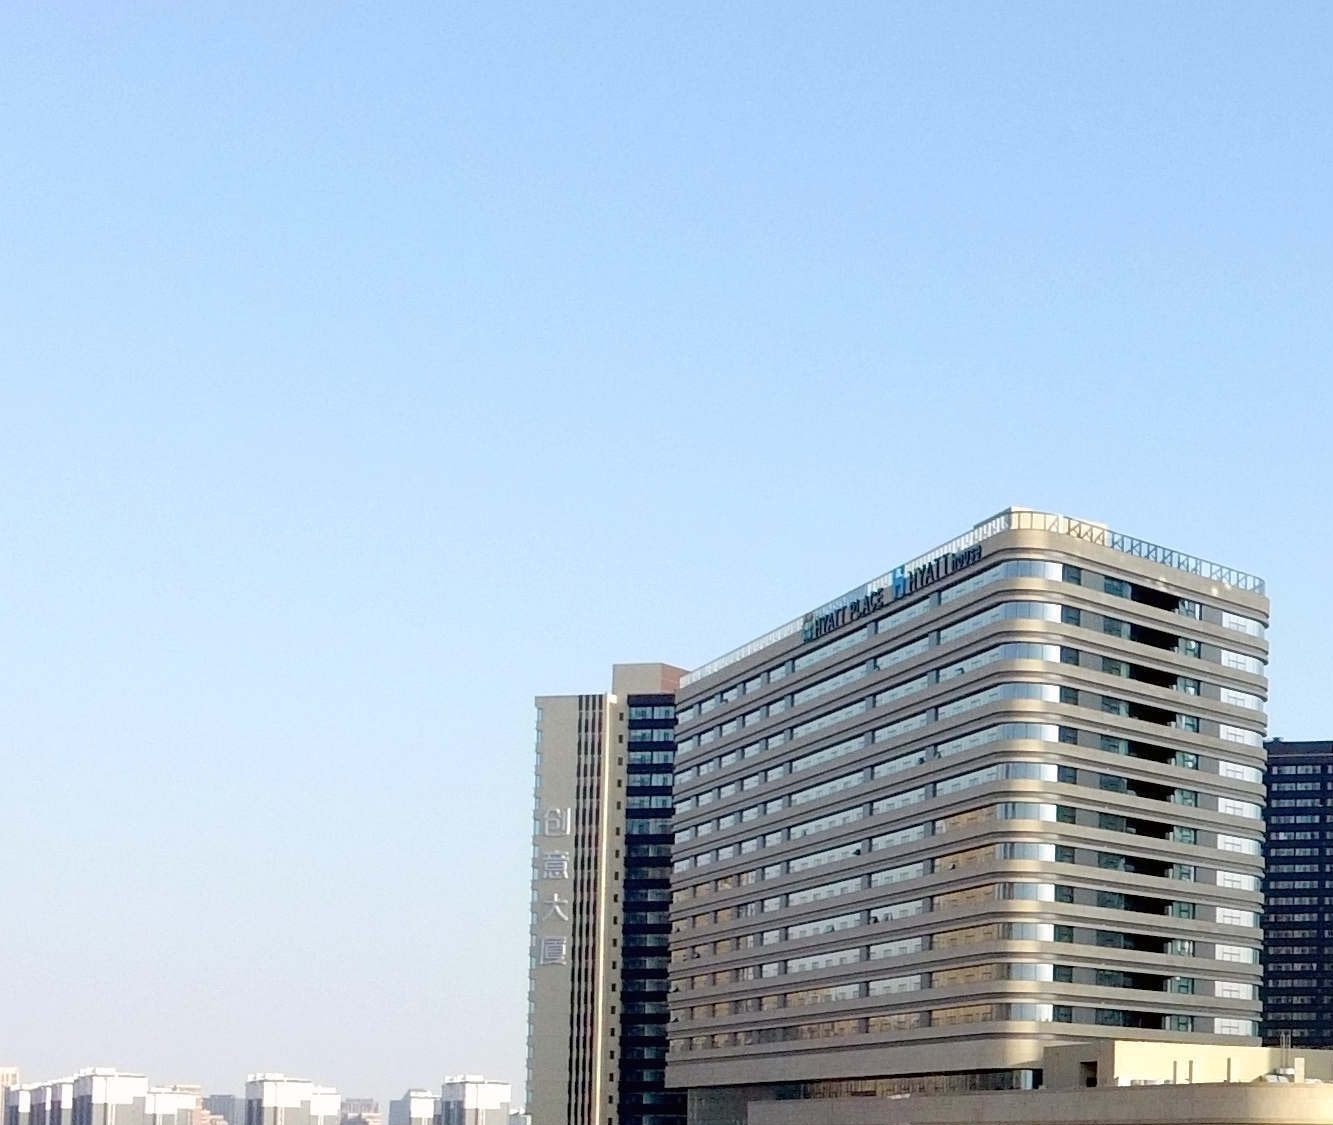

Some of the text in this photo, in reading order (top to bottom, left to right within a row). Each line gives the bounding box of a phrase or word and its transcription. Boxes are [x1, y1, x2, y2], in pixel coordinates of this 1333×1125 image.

[908, 552, 951, 592] HYATT
[815, 587, 884, 638] HYATT PLACE
